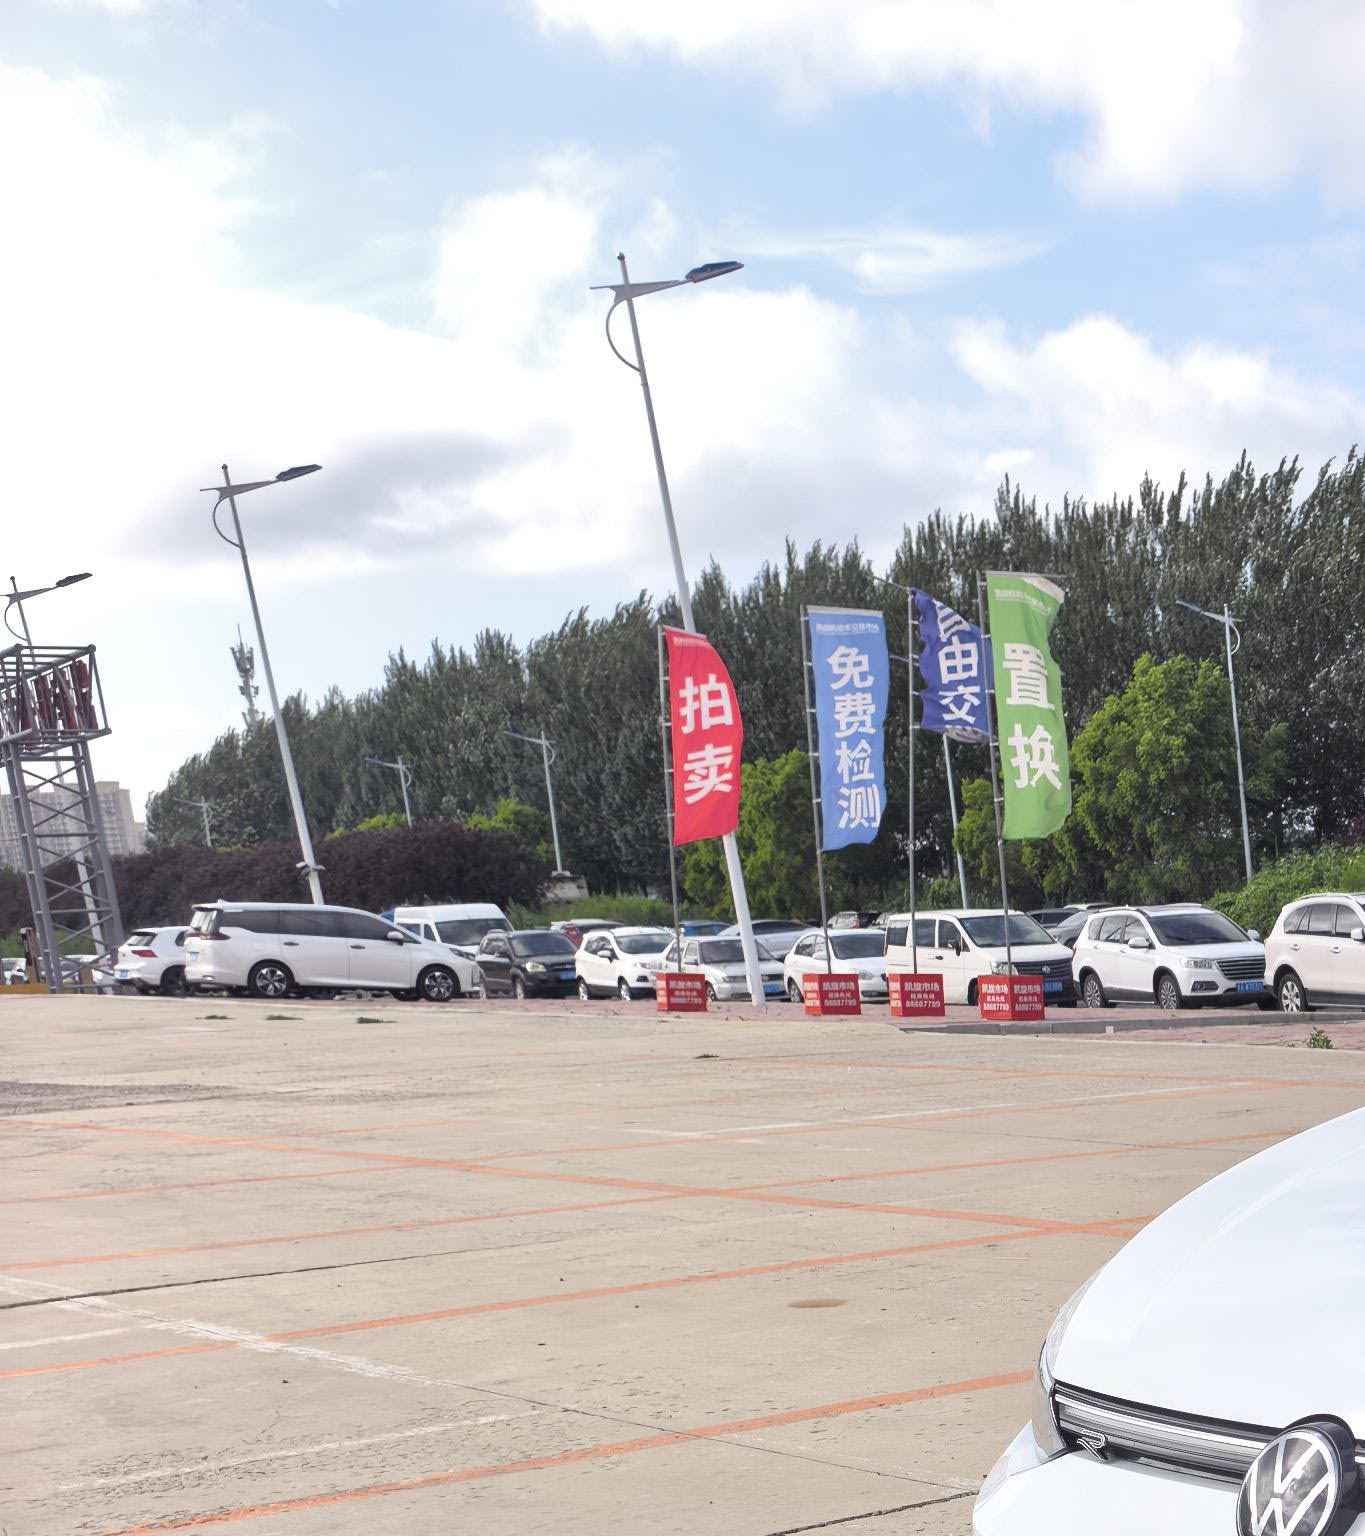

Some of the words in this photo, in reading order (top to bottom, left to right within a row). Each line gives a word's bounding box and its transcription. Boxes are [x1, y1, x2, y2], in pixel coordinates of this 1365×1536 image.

[932, 599, 981, 727] 自由交
[1002, 643, 1064, 791] 置换
[679, 673, 735, 805] 拍卖
[826, 644, 883, 830] 免费检测
